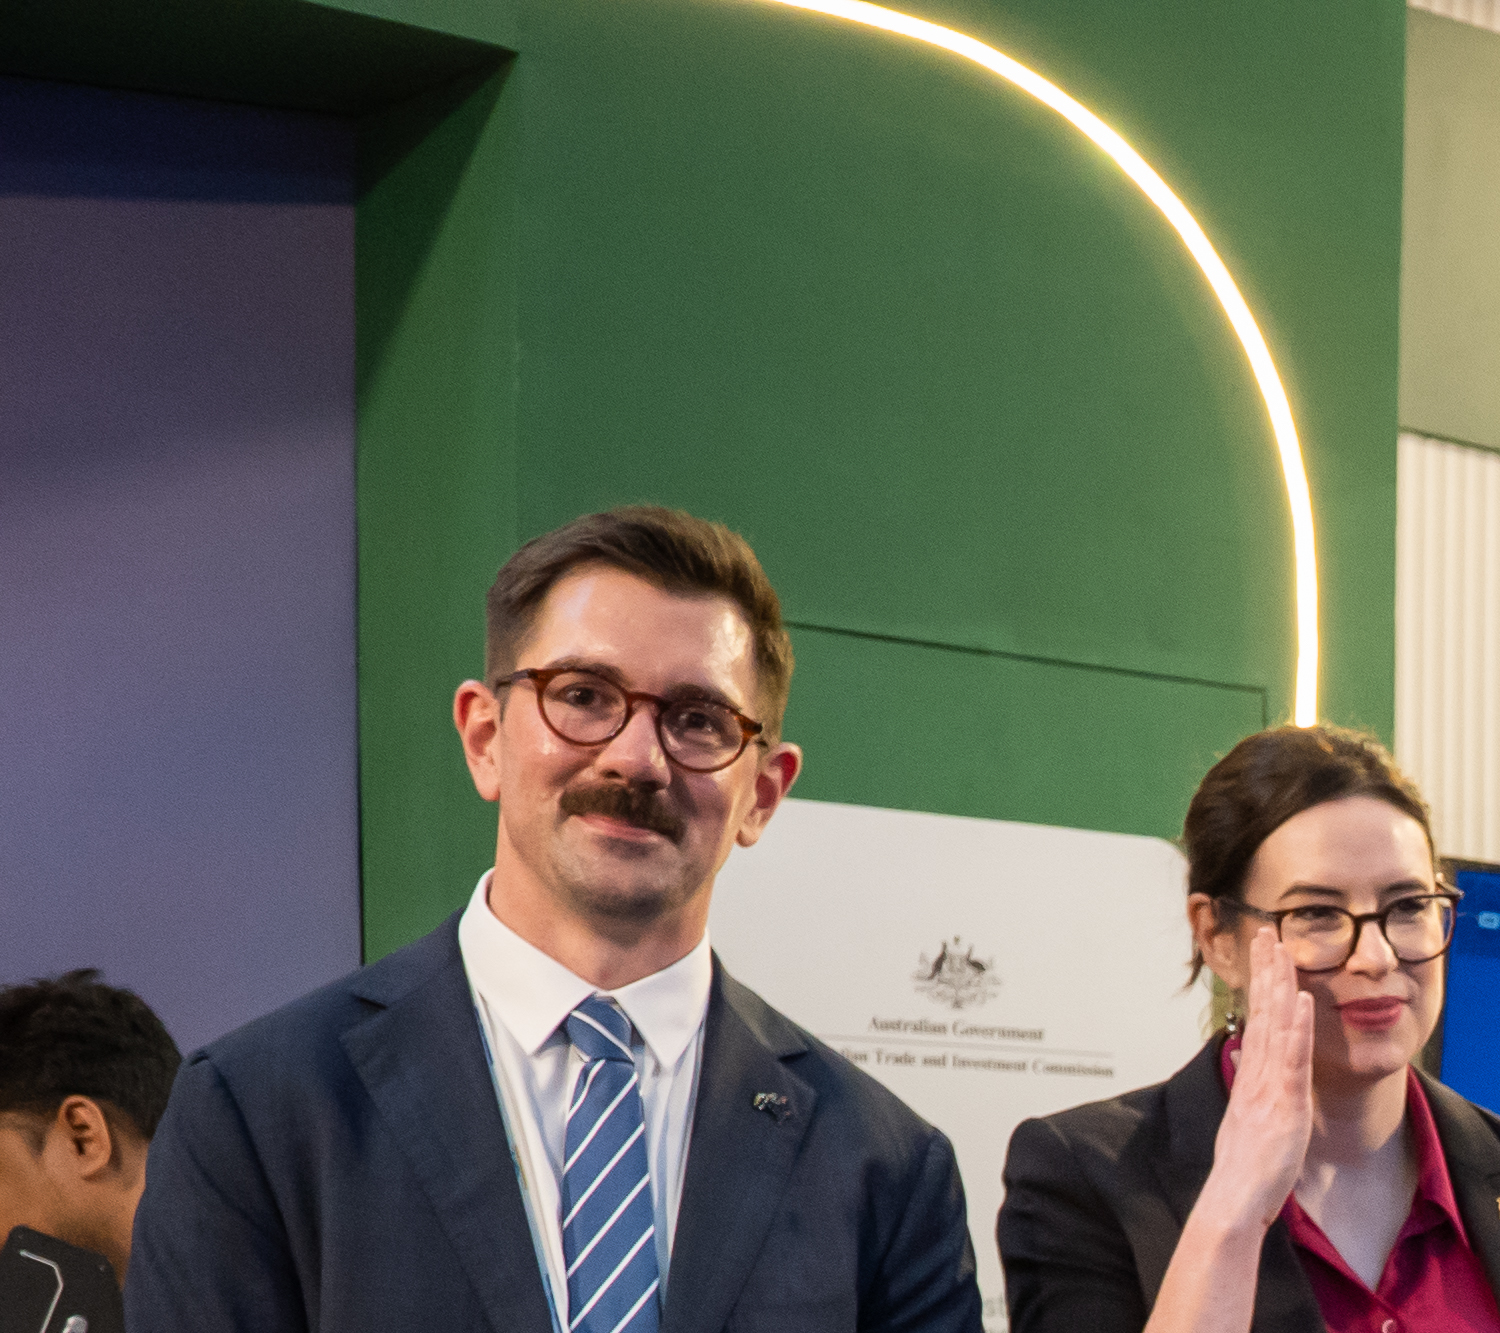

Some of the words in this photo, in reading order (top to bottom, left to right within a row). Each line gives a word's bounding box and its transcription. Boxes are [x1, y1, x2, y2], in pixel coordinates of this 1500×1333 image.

[869, 1016, 947, 1035] Australian
[952, 1021, 1045, 1042] Government
[876, 1049, 916, 1066] Trade
[922, 1053, 946, 1068] and
[952, 1054, 1027, 1073] Investment
[1032, 1059, 1114, 1078] Commission
